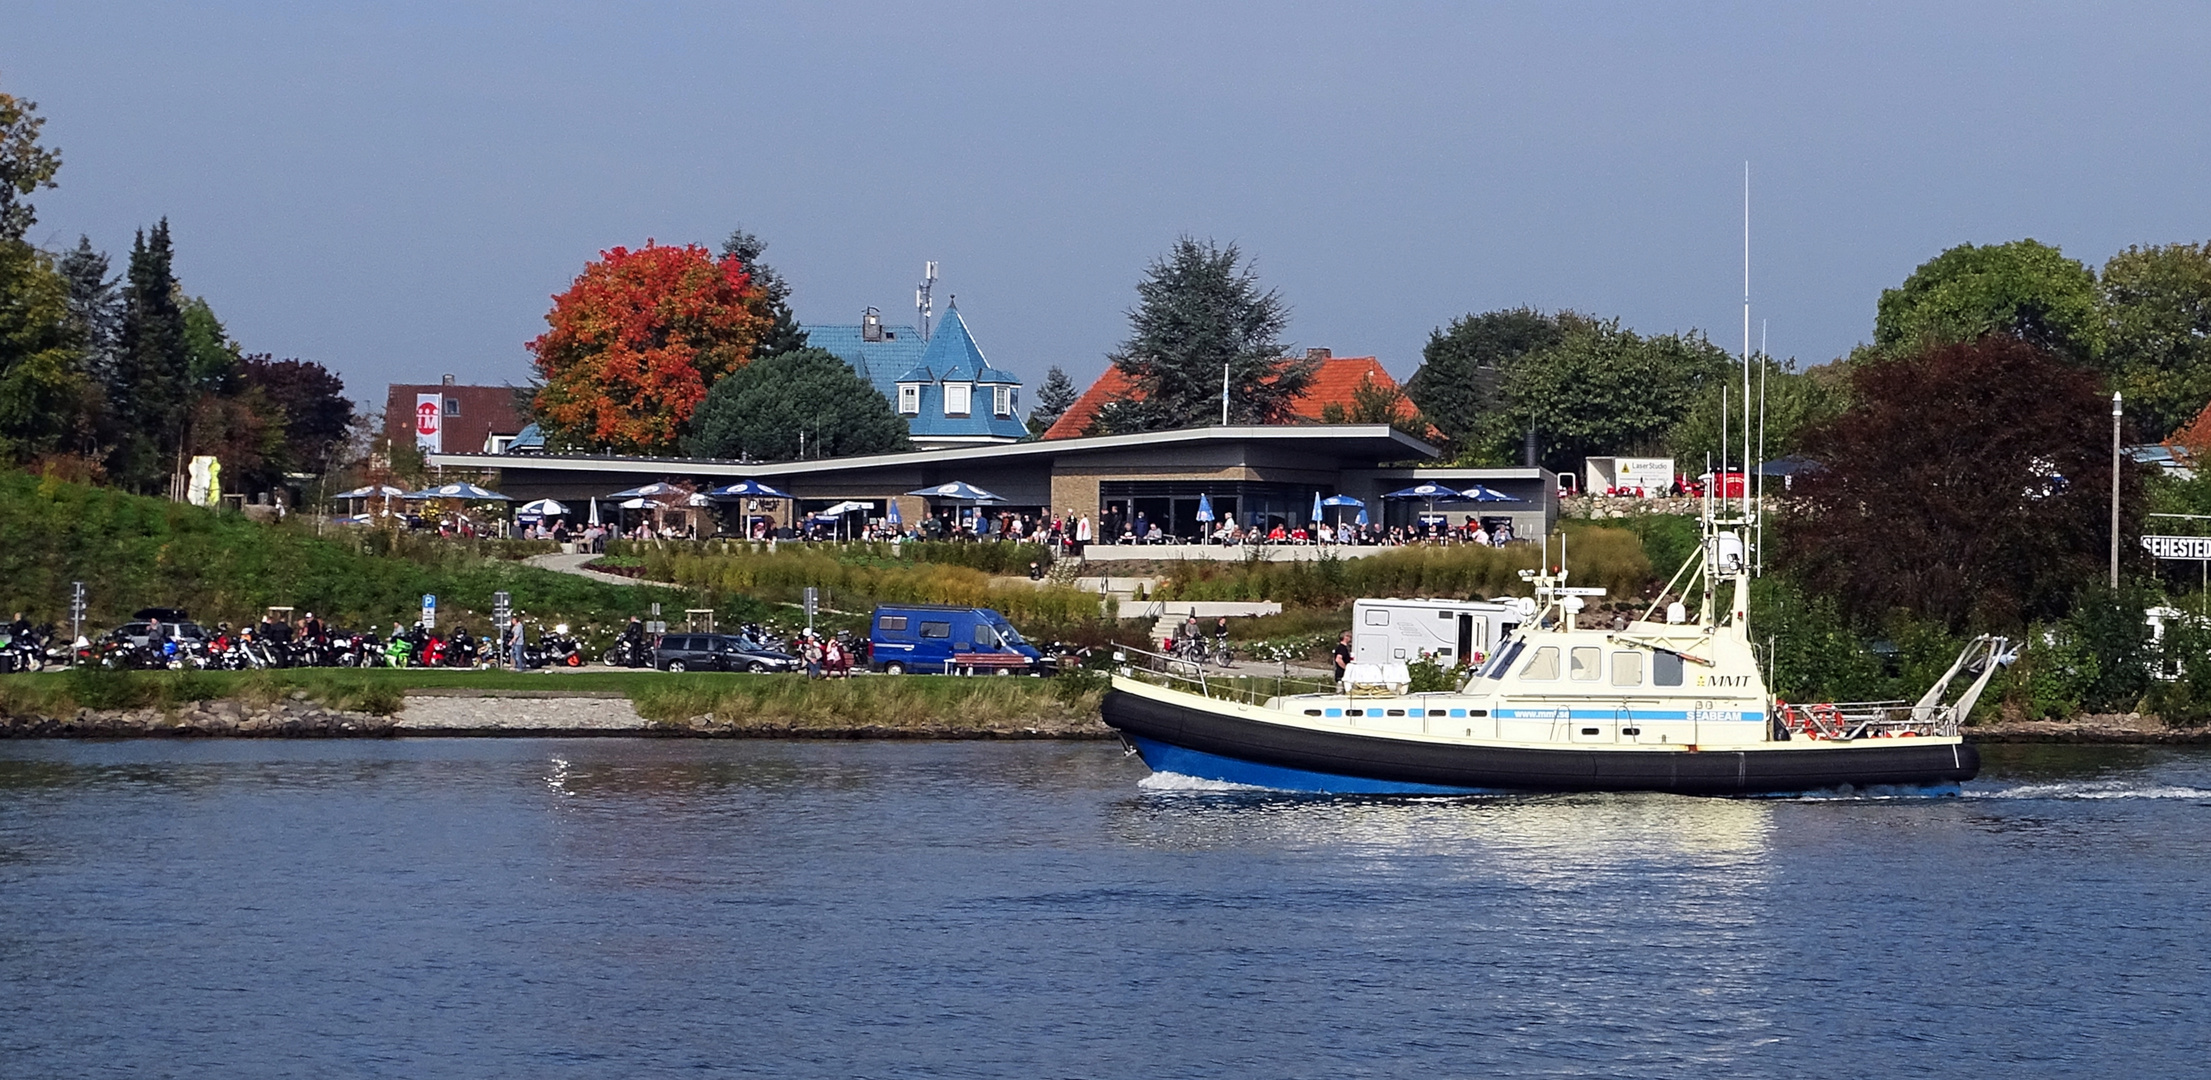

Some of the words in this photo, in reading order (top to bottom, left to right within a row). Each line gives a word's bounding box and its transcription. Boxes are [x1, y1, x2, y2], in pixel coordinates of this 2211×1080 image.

[2142, 537, 2211, 557] SEHESTED
[424, 597, 433, 607] P
[1708, 675, 1751, 687] MMT
[1686, 711, 1741, 720] SEABEAM
